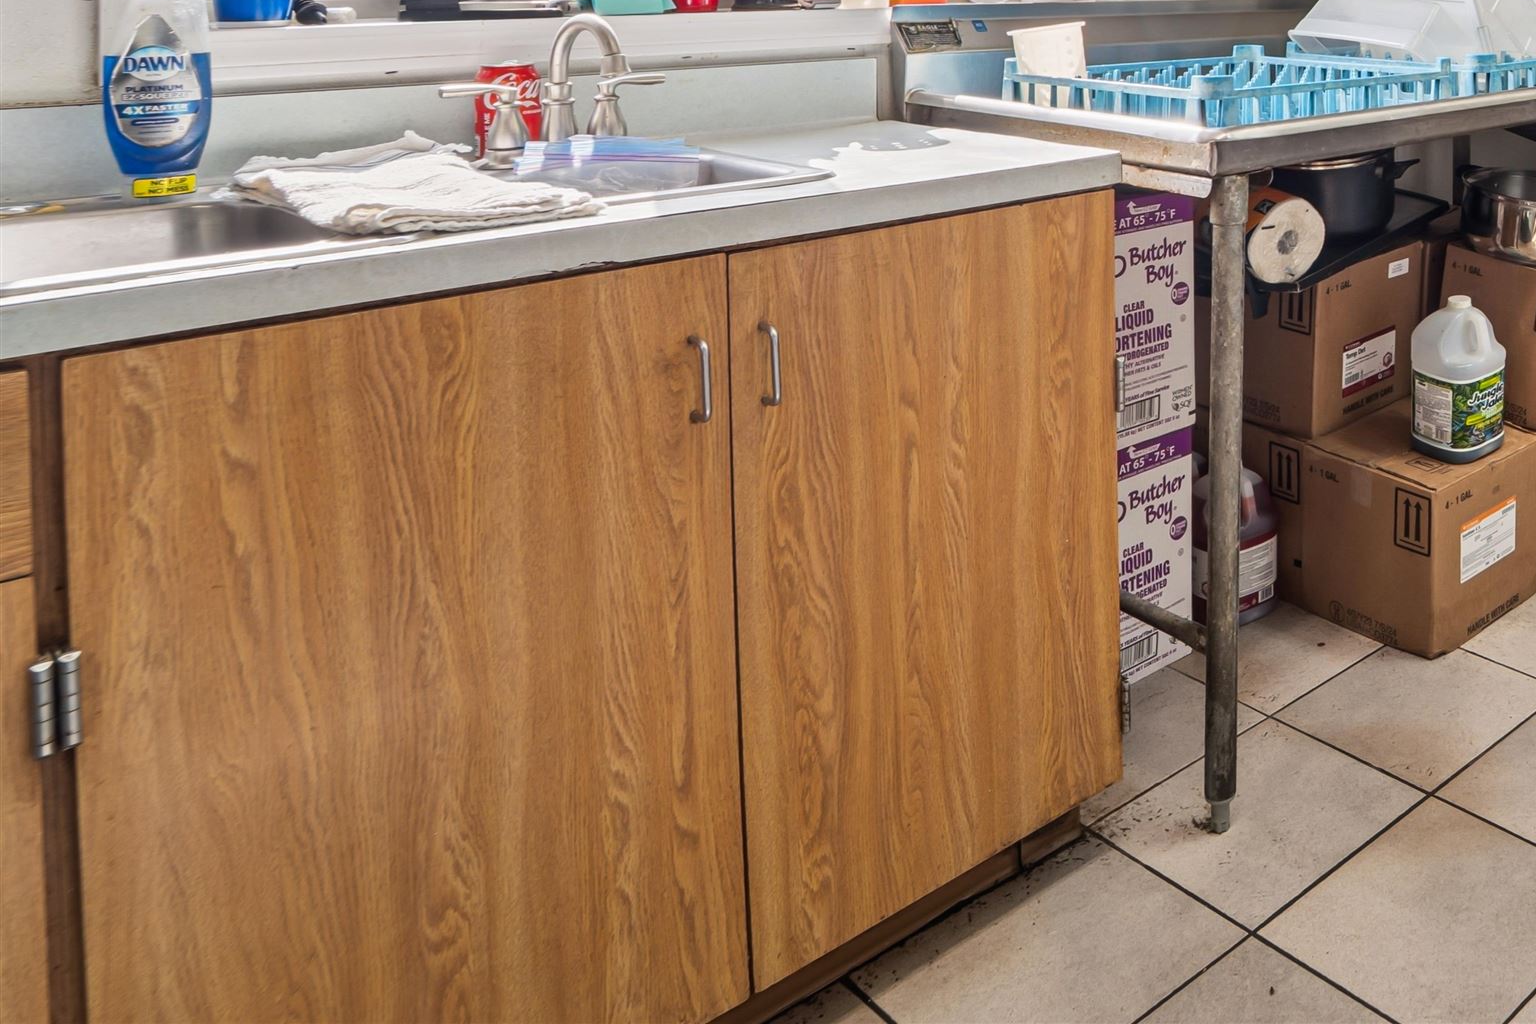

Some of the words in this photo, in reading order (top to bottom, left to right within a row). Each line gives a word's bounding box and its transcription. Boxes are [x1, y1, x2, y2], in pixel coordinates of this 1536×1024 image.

[123, 55, 184, 73] DAWN
[125, 84, 183, 93] PLATINUM
[122, 105, 144, 115] 4X
[145, 104, 189, 112] FASTER
[1119, 218, 1131, 229] AT
[1128, 237, 1187, 267] Butcher
[1145, 263, 1174, 288] Boy
[1123, 301, 1145, 313] CLEAR
[1115, 309, 1154, 332] LIQUID
[1116, 323, 1172, 353] ORTENING
[1122, 342, 1169, 361] DROGENATED
[1119, 462, 1131, 475] AT
[1128, 474, 1186, 510] Butcher
[1144, 500, 1173, 524] Boy
[1123, 541, 1145, 558] CLEAR
[1120, 548, 1153, 576] IQUID
[1121, 560, 1170, 593] RTENING
[1467, 613, 1490, 636] HANDLE
[1490, 603, 1505, 619] WITH
[1505, 592, 1519, 609] CARE
